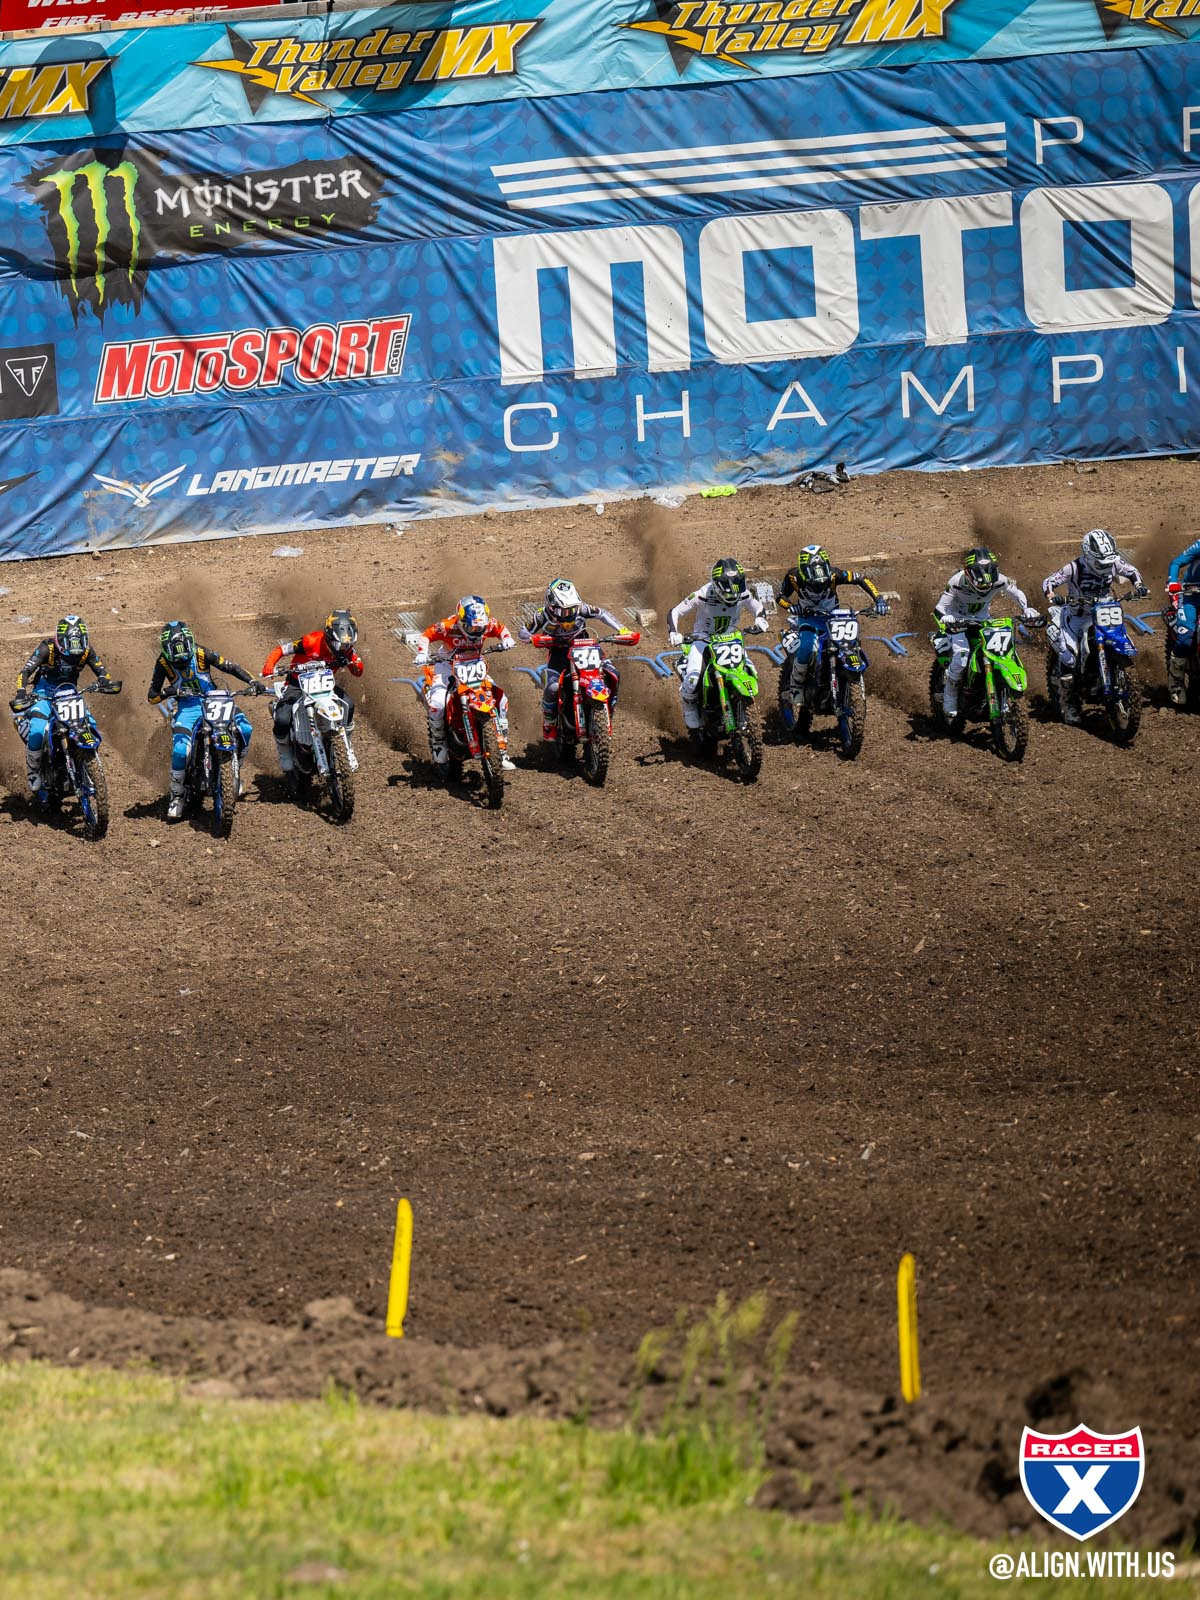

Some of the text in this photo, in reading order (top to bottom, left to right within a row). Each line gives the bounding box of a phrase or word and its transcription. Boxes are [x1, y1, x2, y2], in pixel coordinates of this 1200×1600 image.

[701, 24, 840, 55] Valley
[247, 22, 537, 82] Thunder MX
[275, 61, 409, 93] Valley
[153, 169, 372, 218] MONSTER
[189, 212, 336, 238] ENERGY
[493, 183, 1200, 386] MOTO
[97, 319, 408, 400] MOTOSPORT
[186, 452, 423, 497] LANDMASTER
[1095, 606, 1123, 627] 69
[831, 621, 859, 641] 59
[986, 631, 1012, 652] 47
[573, 646, 601, 670] 34
[716, 643, 743, 666] 29
[456, 660, 487, 683] 929
[302, 675, 334, 695] 186
[57, 699, 85, 722] 511
[206, 701, 234, 721] 31
